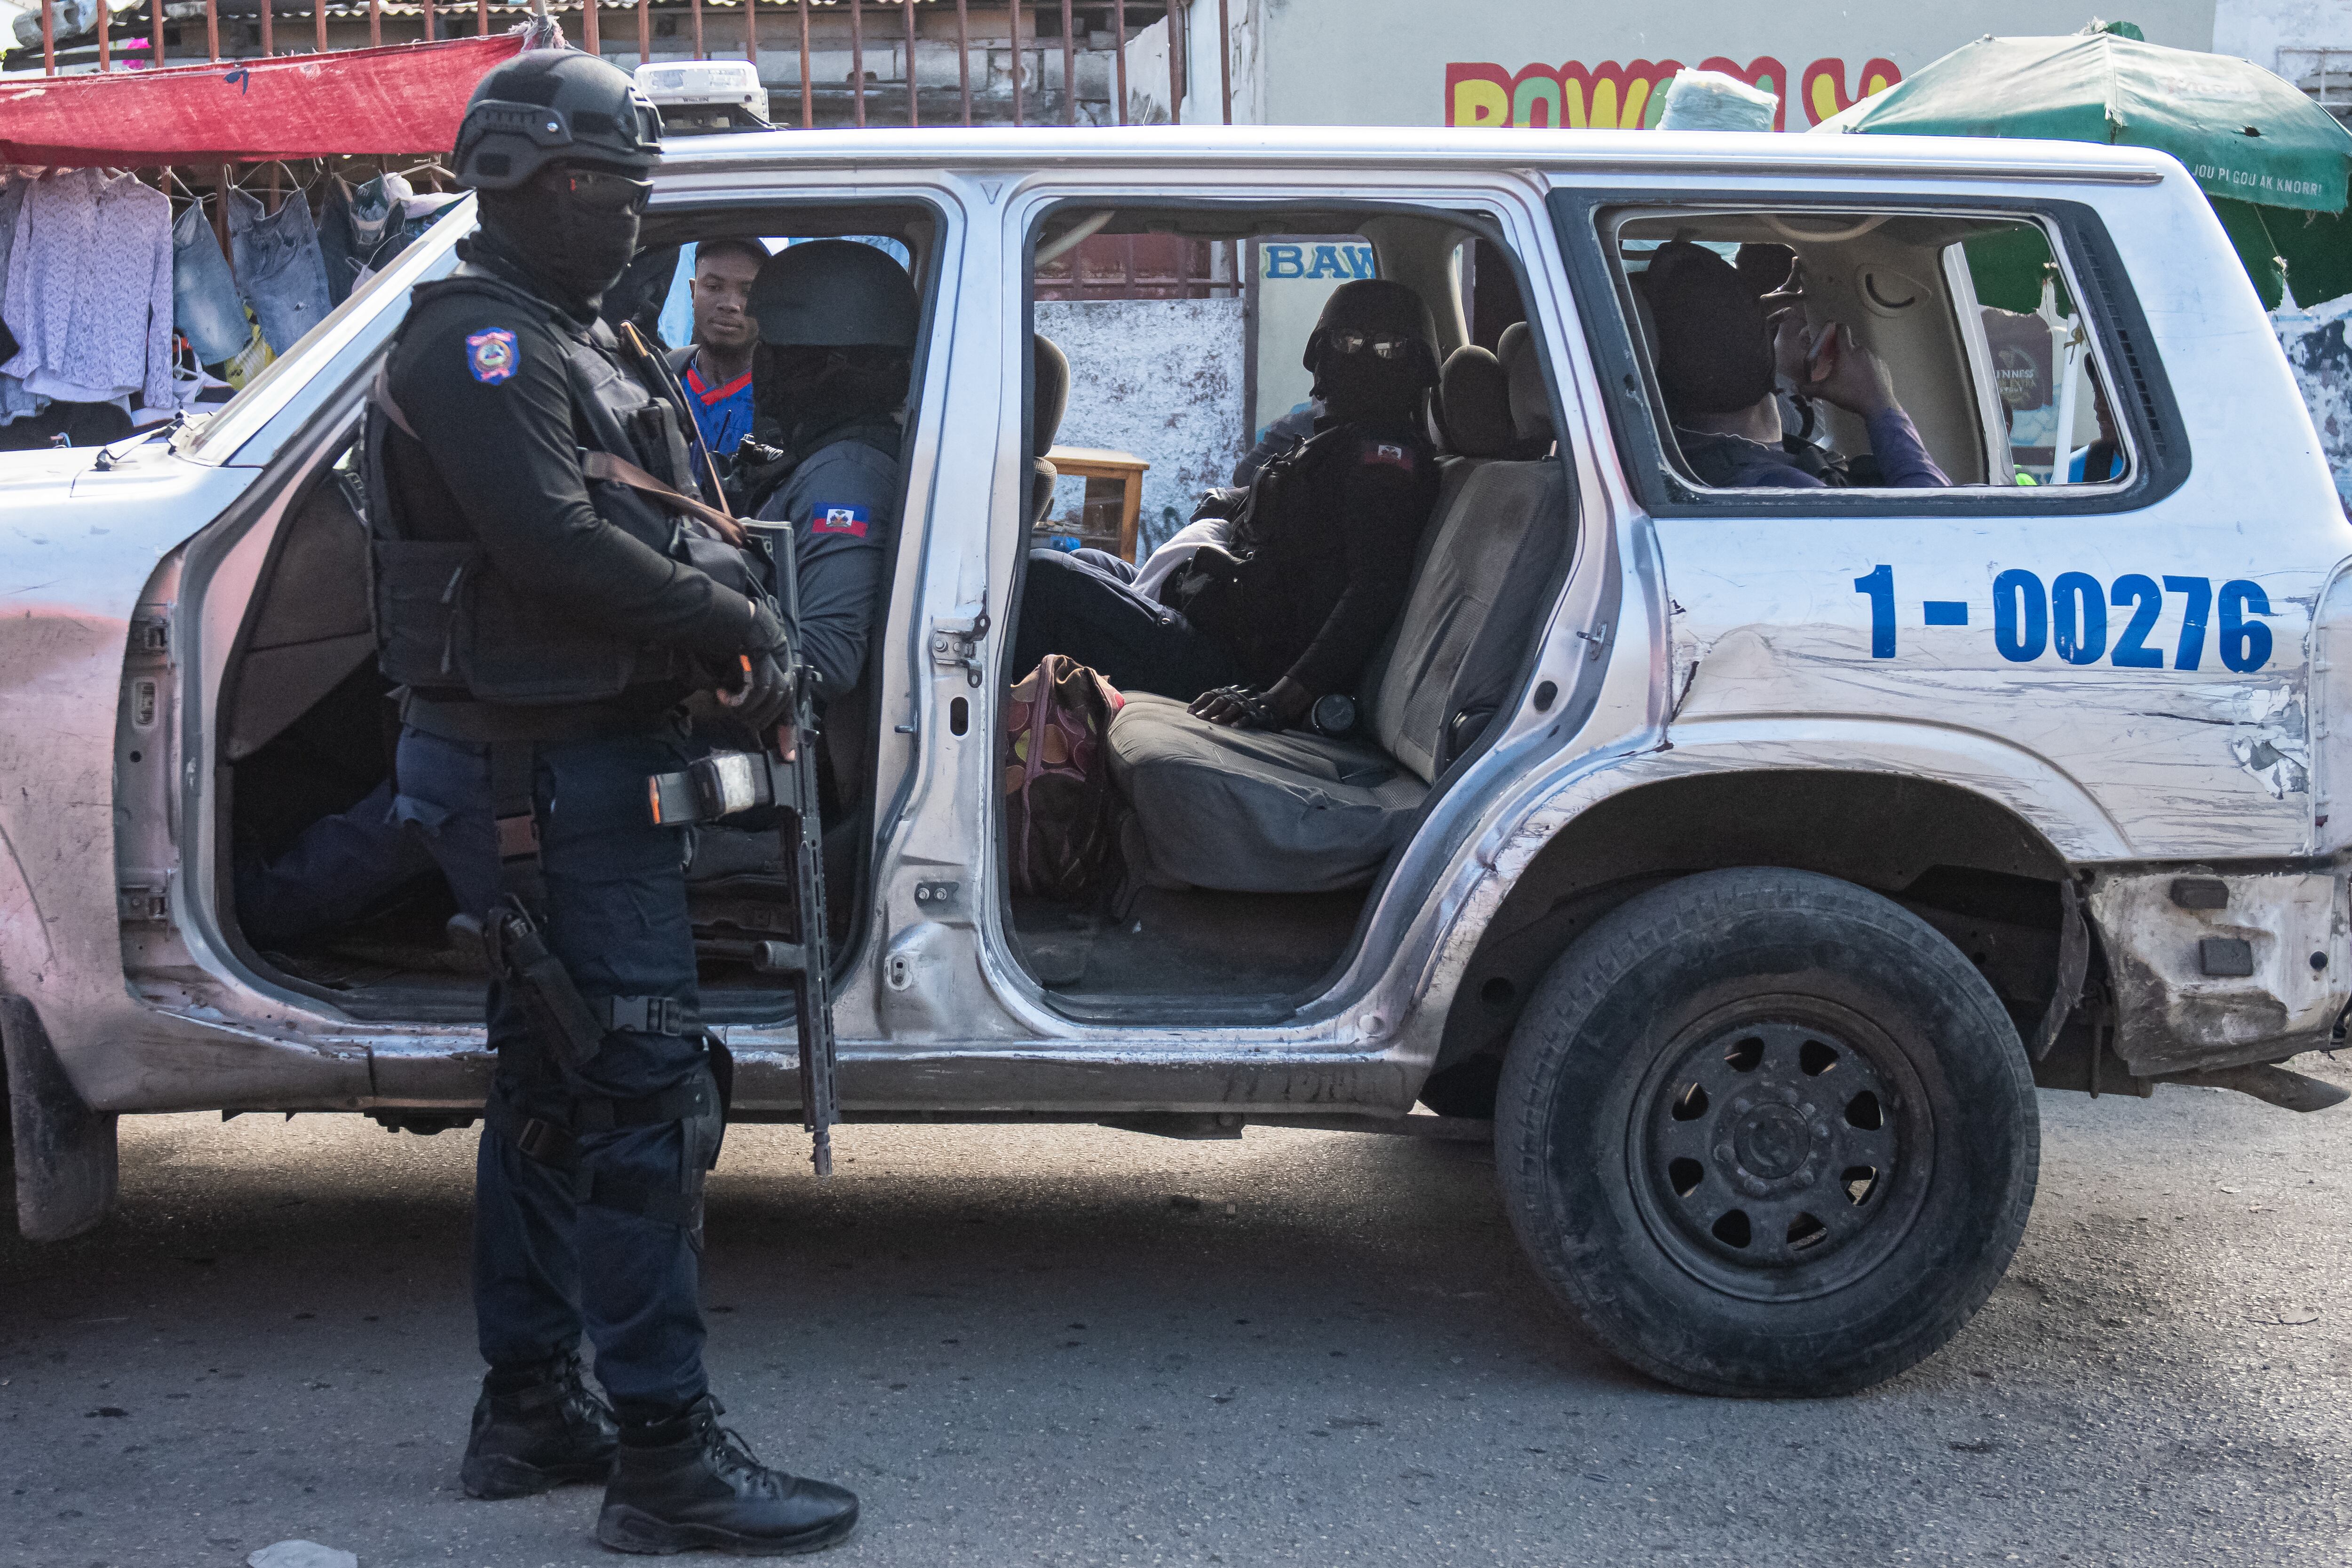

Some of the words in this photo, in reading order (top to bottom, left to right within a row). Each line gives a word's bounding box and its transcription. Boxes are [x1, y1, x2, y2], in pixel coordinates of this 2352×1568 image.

[2192, 164, 2215, 179] JOU
[2218, 167, 2229, 181] PI
[2233, 170, 2257, 186] GOU
[2260, 175, 2273, 190] AK
[1265, 245, 1376, 278] BAW
[1995, 369, 2034, 378] INNESS
